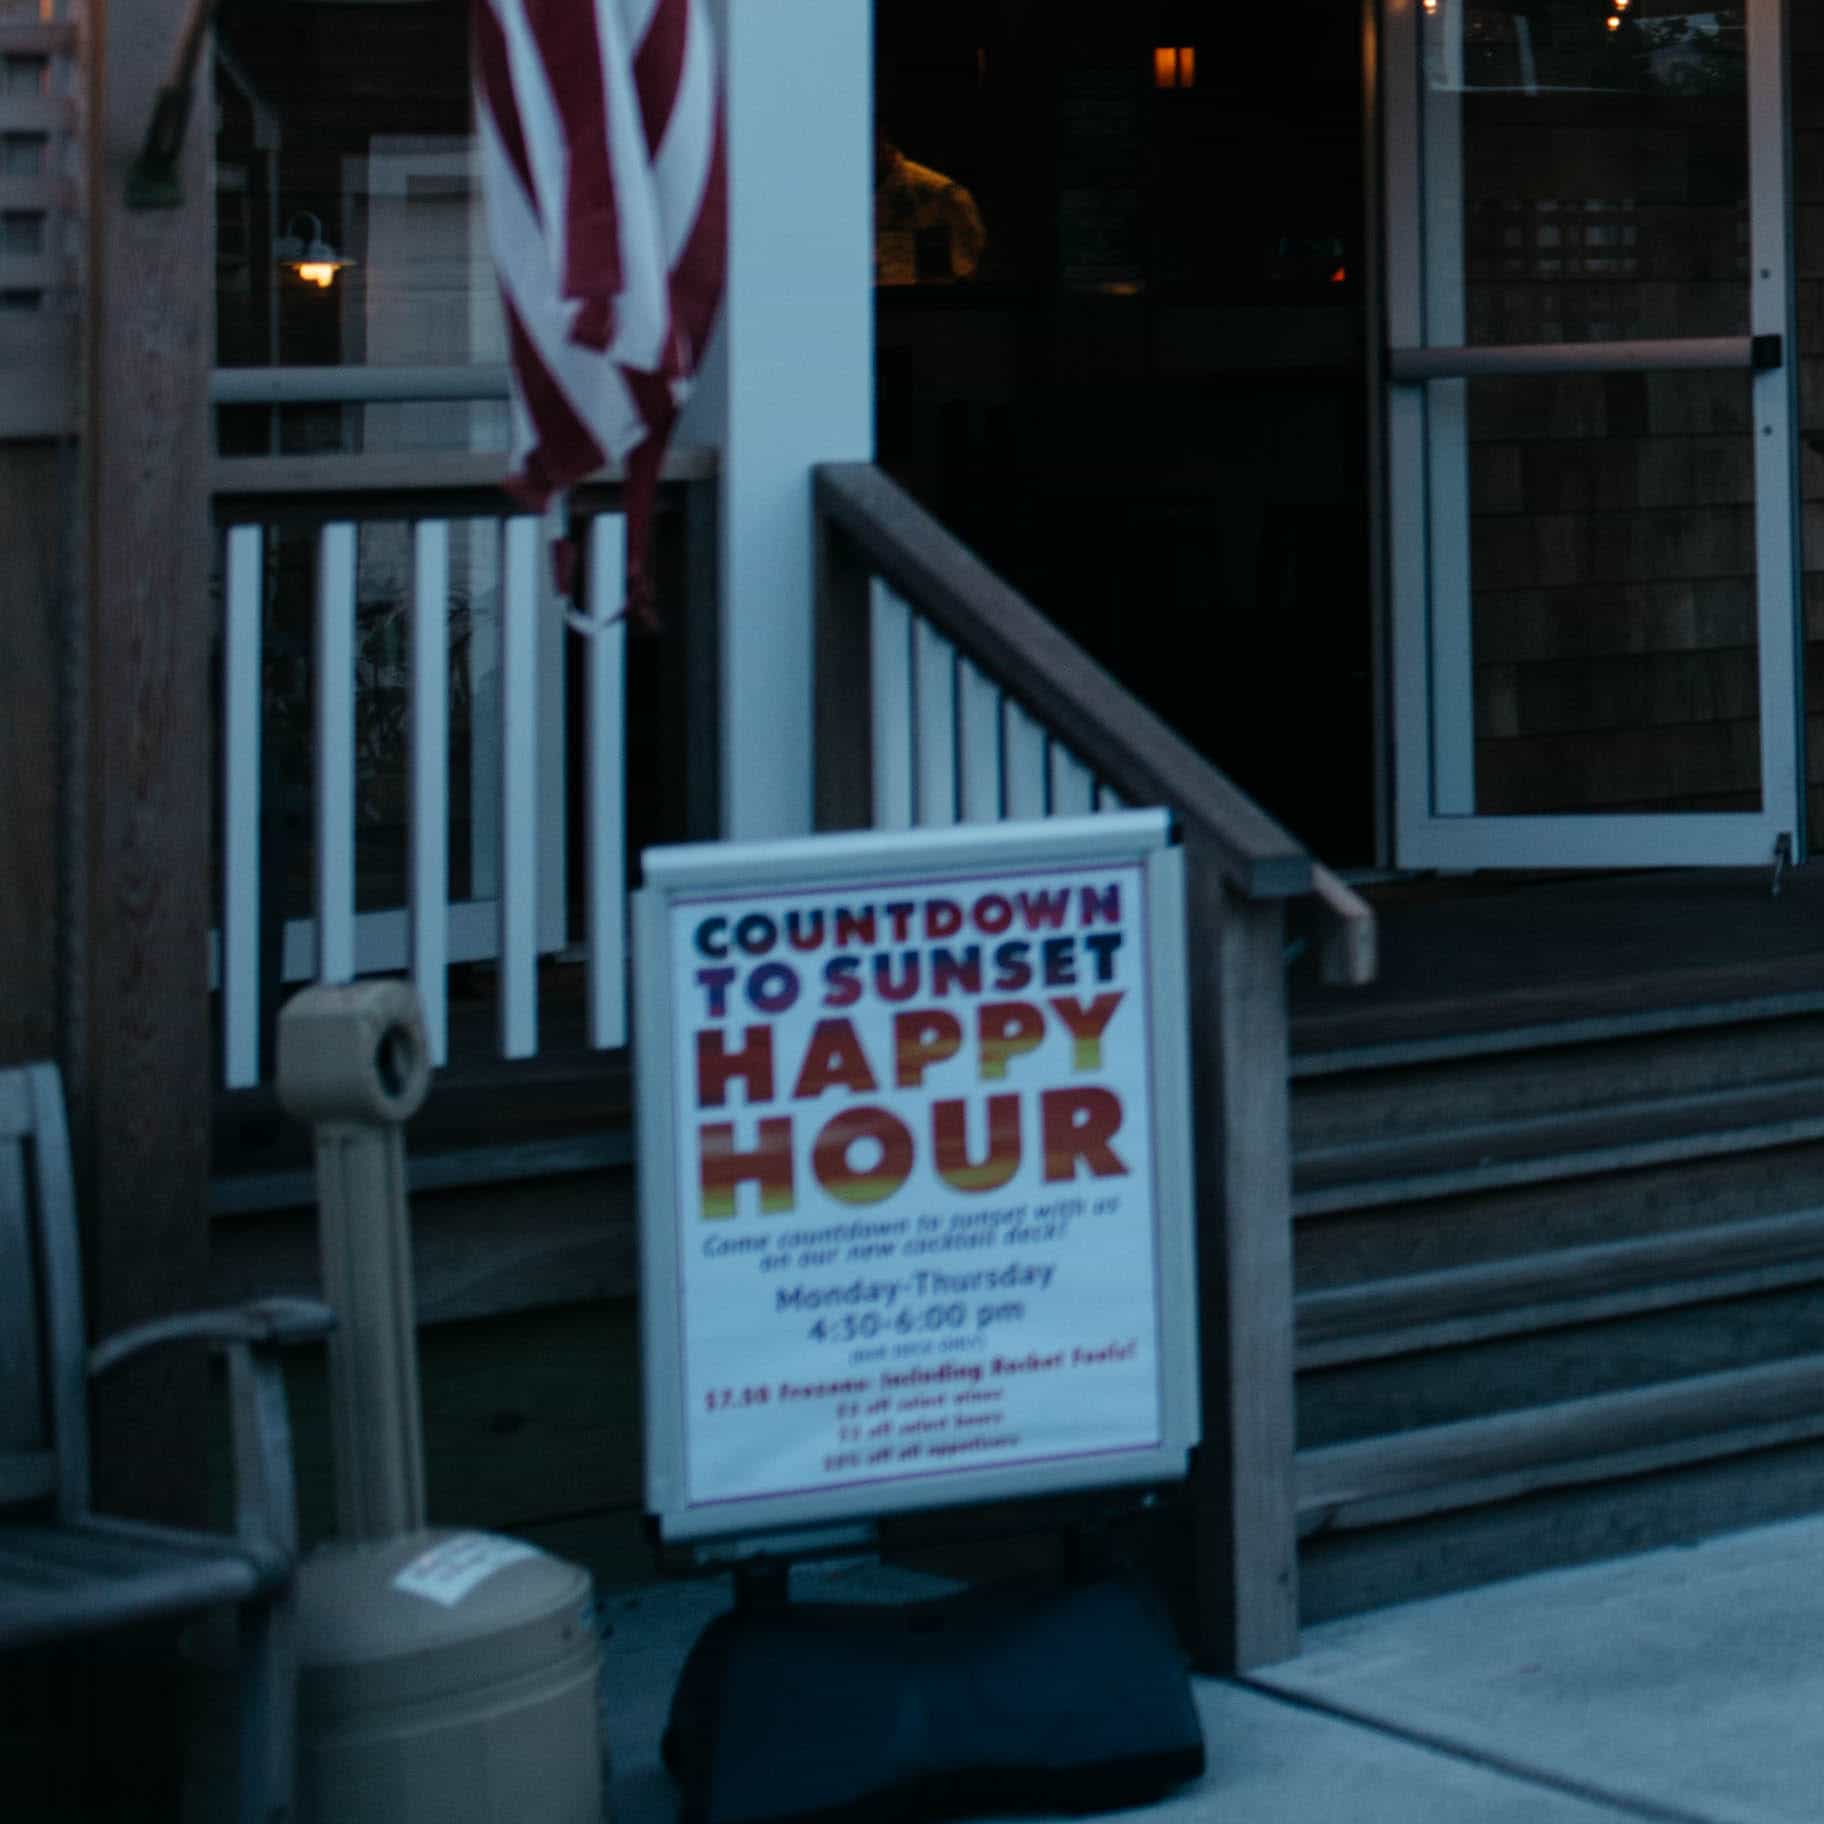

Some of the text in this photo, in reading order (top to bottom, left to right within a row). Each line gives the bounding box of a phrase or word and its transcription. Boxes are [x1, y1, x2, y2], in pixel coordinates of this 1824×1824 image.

[694, 883, 1121, 960] COUNTDOWN
[695, 932, 1123, 1018] TO SUNSET
[695, 991, 1126, 1109] HAPPY
[699, 1085, 1129, 1220] HOUR
[703, 1233, 768, 1258] Come
[777, 1218, 908, 1250] countdown
[917, 1213, 940, 1232] to
[950, 1204, 1026, 1228] sunset
[1033, 1198, 1086, 1219] with
[759, 1253, 791, 1272] on
[798, 1249, 838, 1268] our
[848, 1242, 895, 1261] new
[902, 1230, 997, 1256] cocktail
[775, 1260, 1056, 1313] Monday-Thursday
[808, 1300, 1026, 1344] 4:30-6:00 pm
